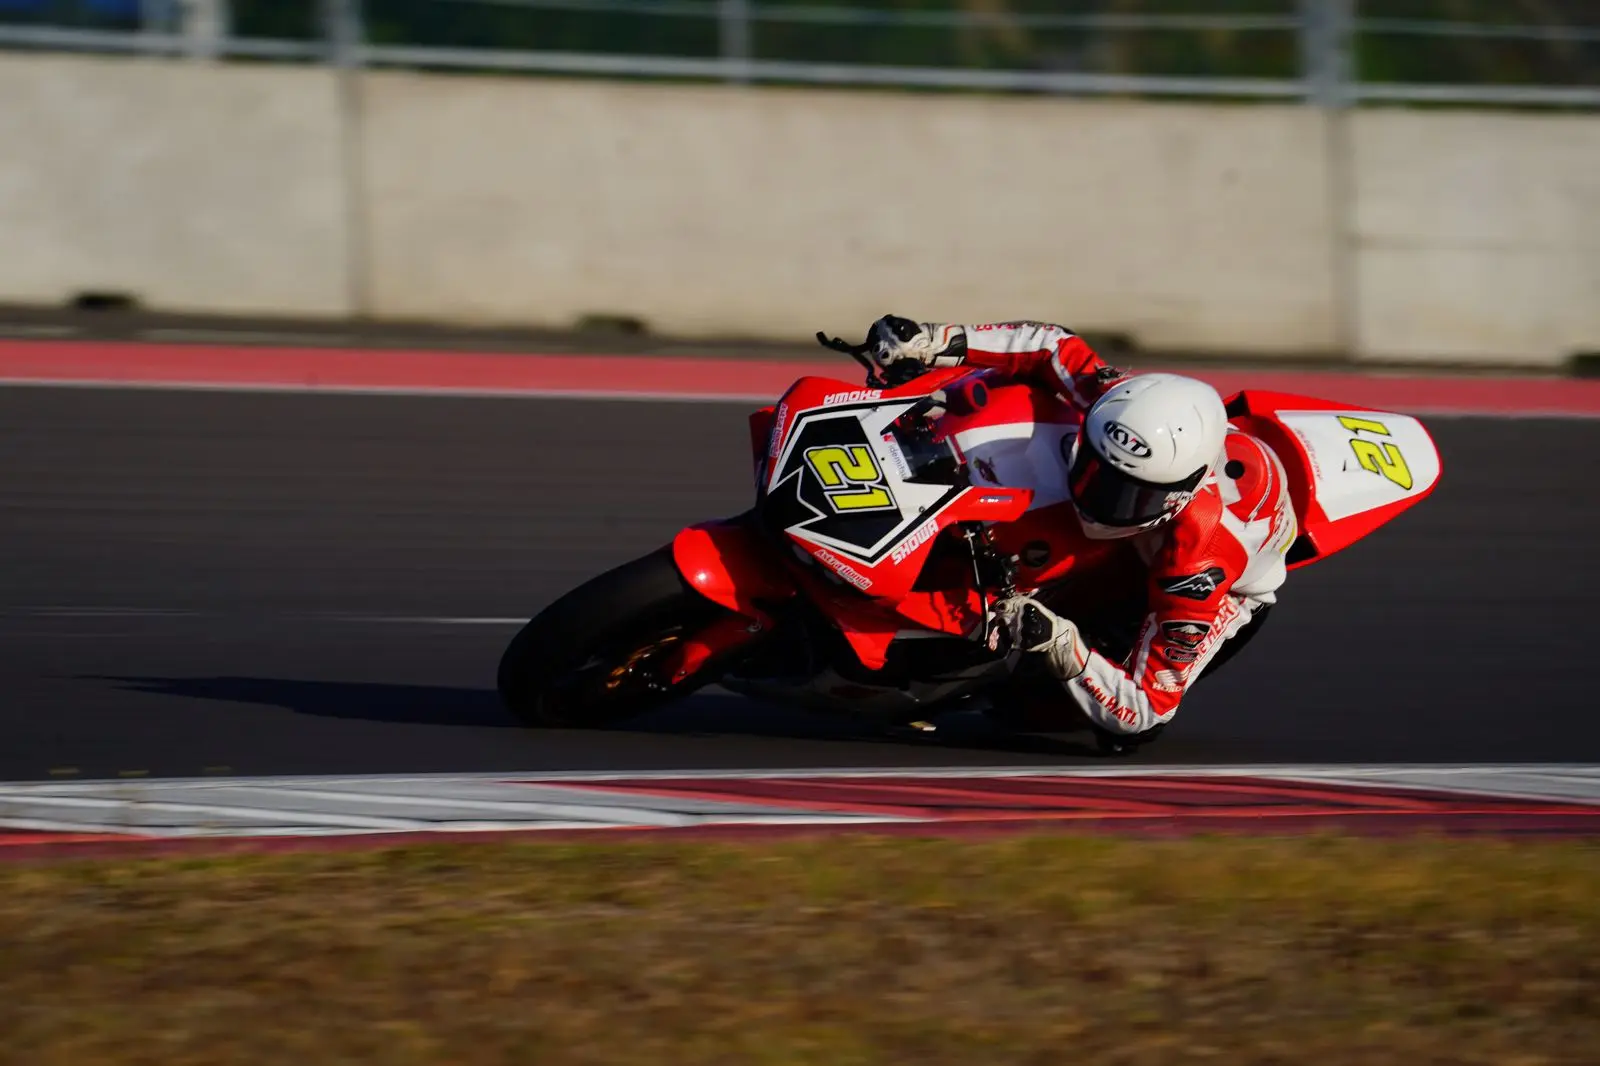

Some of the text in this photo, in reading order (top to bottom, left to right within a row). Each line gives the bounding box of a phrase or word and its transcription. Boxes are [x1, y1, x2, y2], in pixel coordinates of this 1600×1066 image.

[823, 389, 882, 405] SHOWA
[1106, 423, 1144, 452] KYT
[1336, 415, 1414, 491] 21
[803, 444, 897, 514] 21
[891, 519, 939, 566] SHOWA
[1080, 677, 1107, 704] Satu
[1152, 681, 1183, 693] HOND
